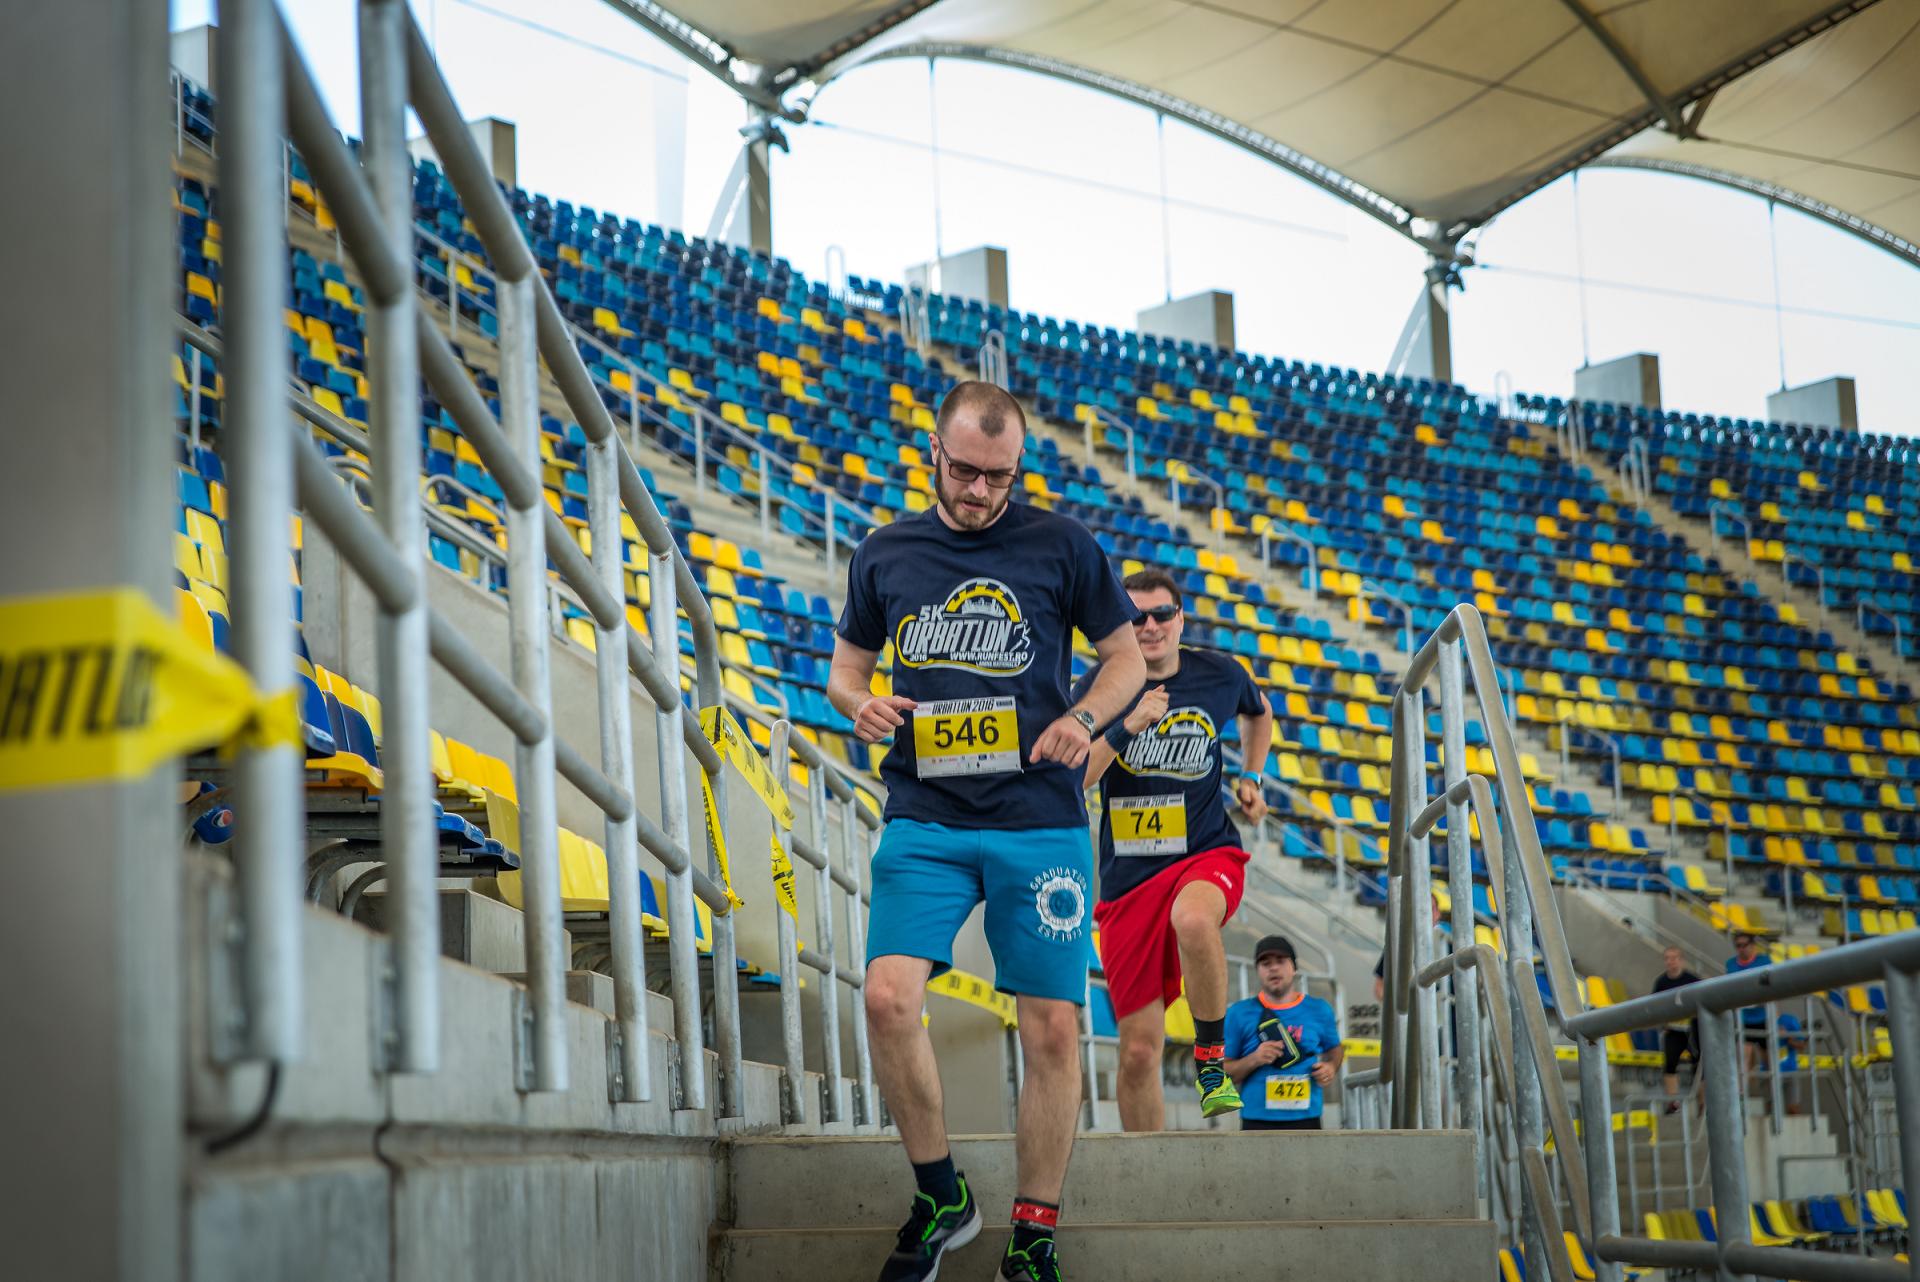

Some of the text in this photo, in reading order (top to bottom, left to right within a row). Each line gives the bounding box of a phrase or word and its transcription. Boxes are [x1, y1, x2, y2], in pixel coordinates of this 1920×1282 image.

[918, 604, 945, 622] 5K
[902, 619, 1013, 656] URBATLON
[950, 650, 1028, 663] WWW.RUNFEST.RO
[970, 697, 994, 712] 2016
[934, 714, 1000, 750] 546
[1130, 809, 1163, 835] 74
[1274, 1082, 1305, 1098] 472
